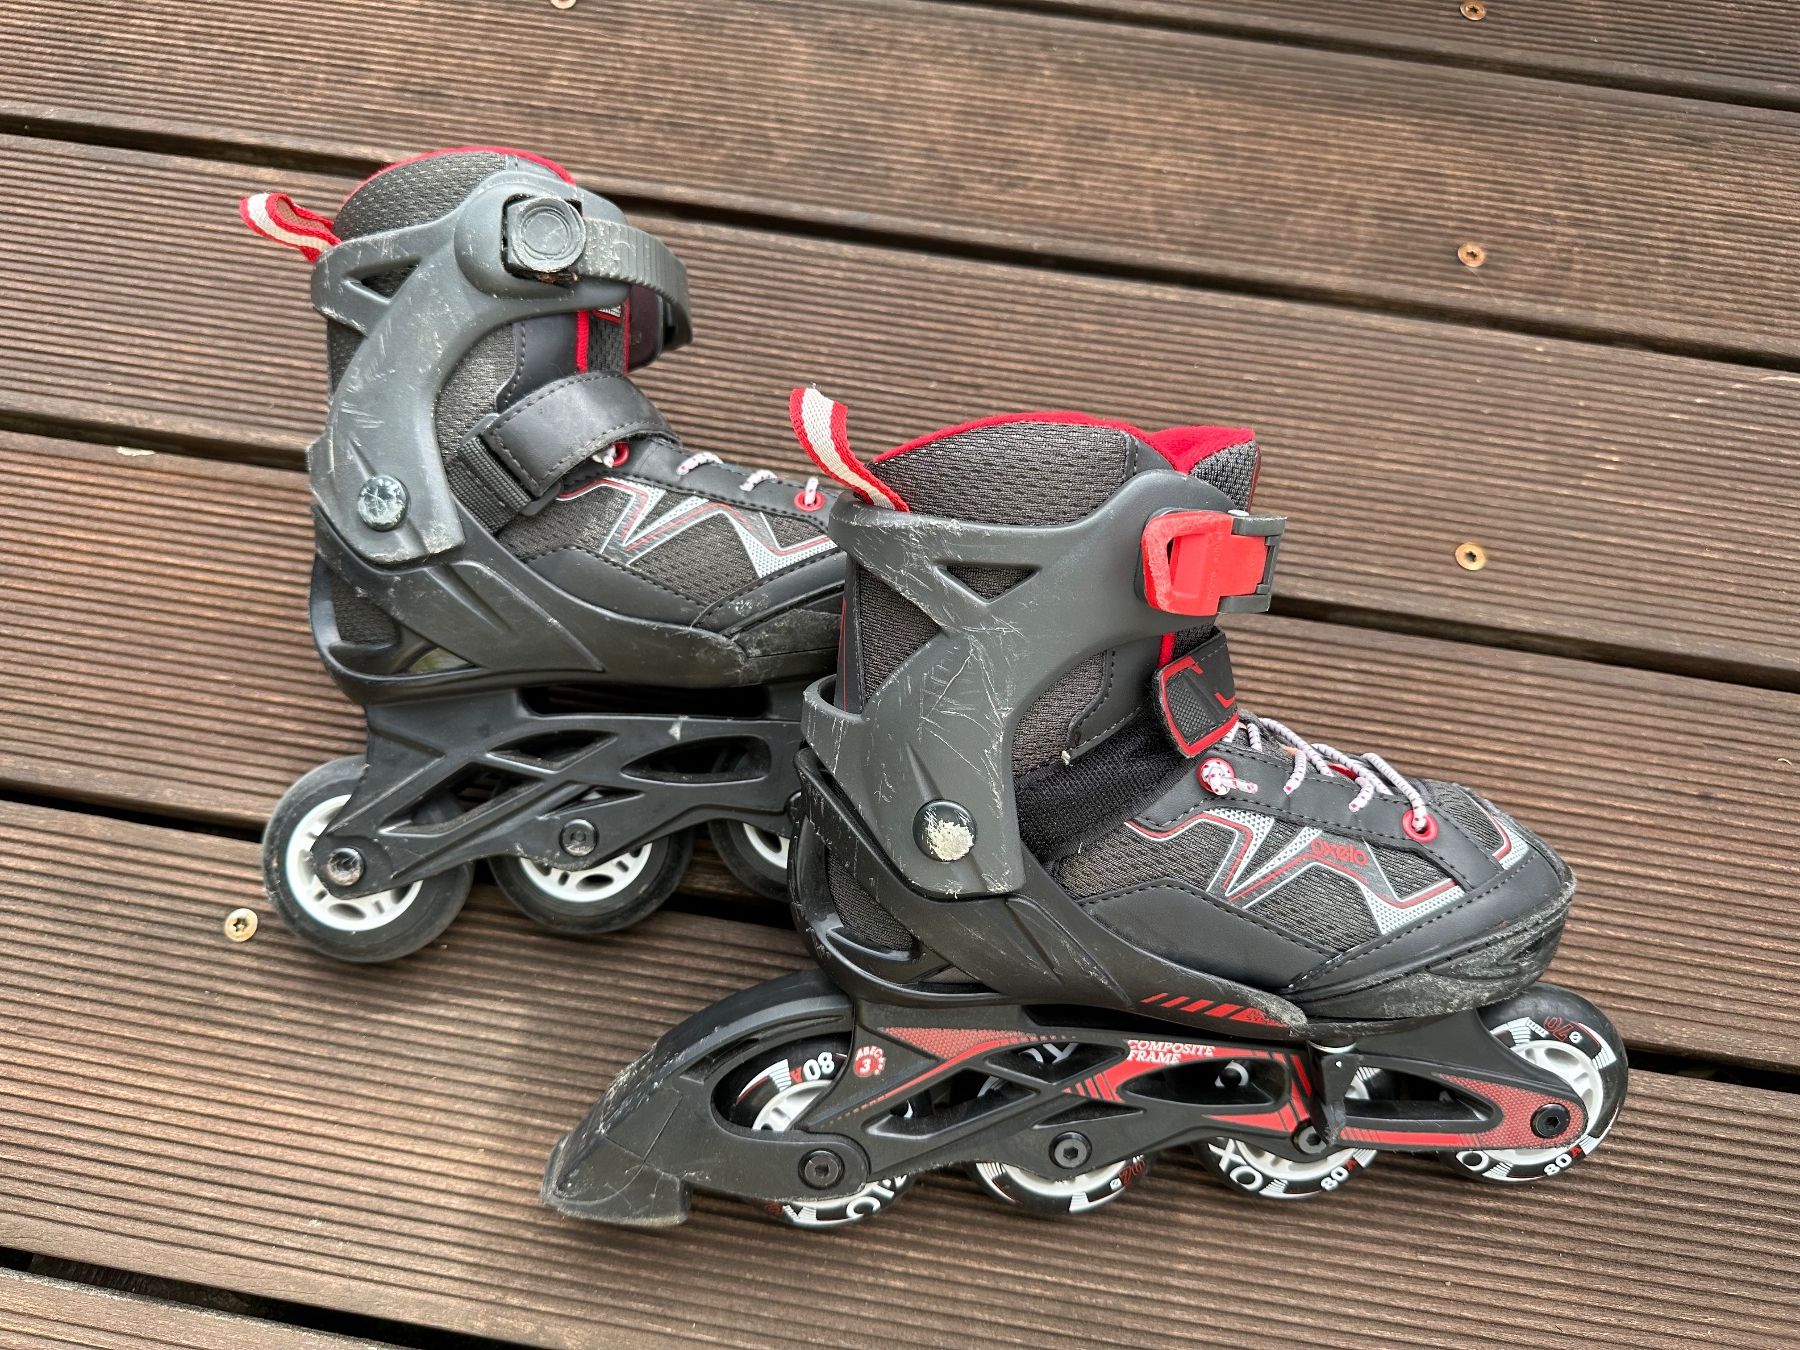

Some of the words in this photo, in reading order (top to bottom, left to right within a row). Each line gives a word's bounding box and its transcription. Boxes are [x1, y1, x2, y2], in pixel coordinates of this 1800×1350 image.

[1127, 1039, 1215, 1057] COMPOSITE
[1126, 1049, 1181, 1064] FRAME
[859, 1058, 872, 1073] 3
